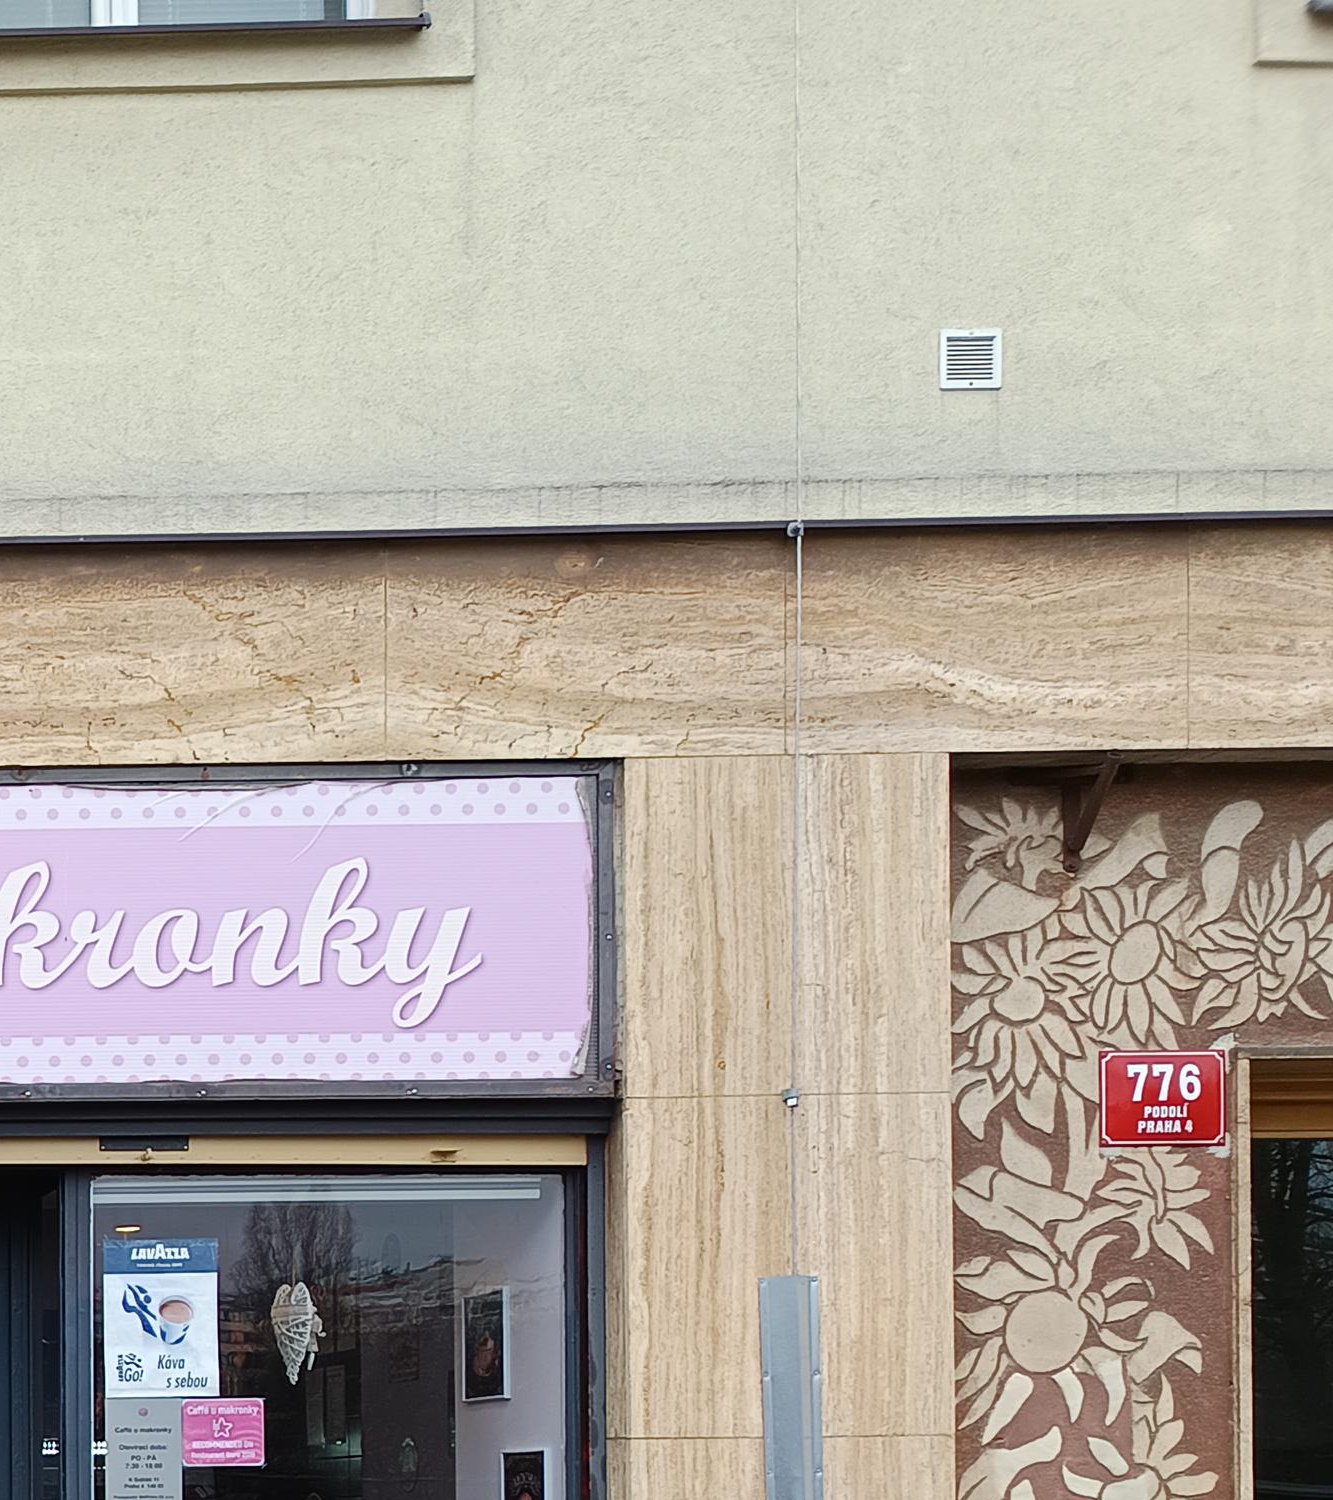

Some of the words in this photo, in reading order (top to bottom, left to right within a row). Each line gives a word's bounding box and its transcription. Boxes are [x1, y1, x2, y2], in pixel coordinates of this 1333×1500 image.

[1126, 1063, 1202, 1103] 776
[1143, 1103, 1188, 1119] PODOLÍ
[1137, 1120, 1182, 1134] PRAHA
[1184, 1120, 1194, 1133] 4
[130, 1243, 190, 1260] LAVAZZA
[157, 1354, 185, 1370] Káva
[124, 1367, 144, 1382] Go!
[165, 1376, 172, 1388] s
[174, 1371, 208, 1388] sebou
